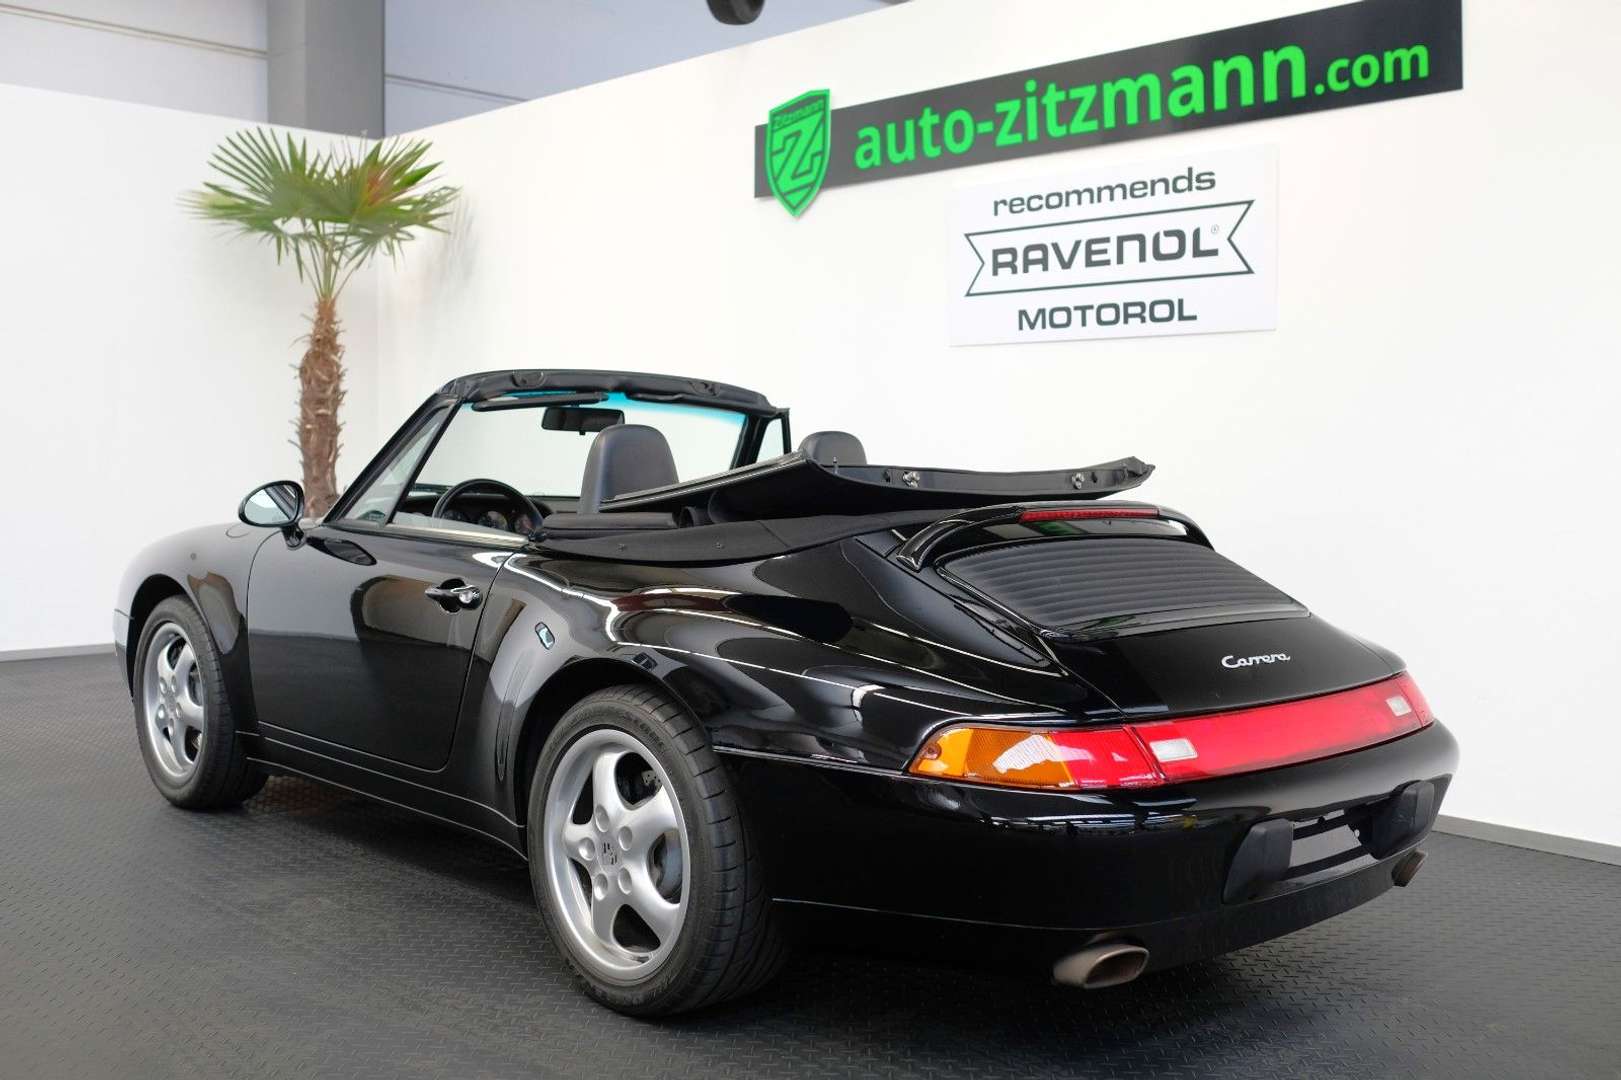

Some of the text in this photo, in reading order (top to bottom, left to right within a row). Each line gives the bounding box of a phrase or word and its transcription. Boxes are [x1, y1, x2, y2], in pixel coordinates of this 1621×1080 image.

[854, 43, 1430, 171] auto-zitzmann.com
[994, 167, 1216, 216] recommends
[1018, 298, 1198, 331] MOTOROL
[1221, 652, 1291, 669] Carrera
